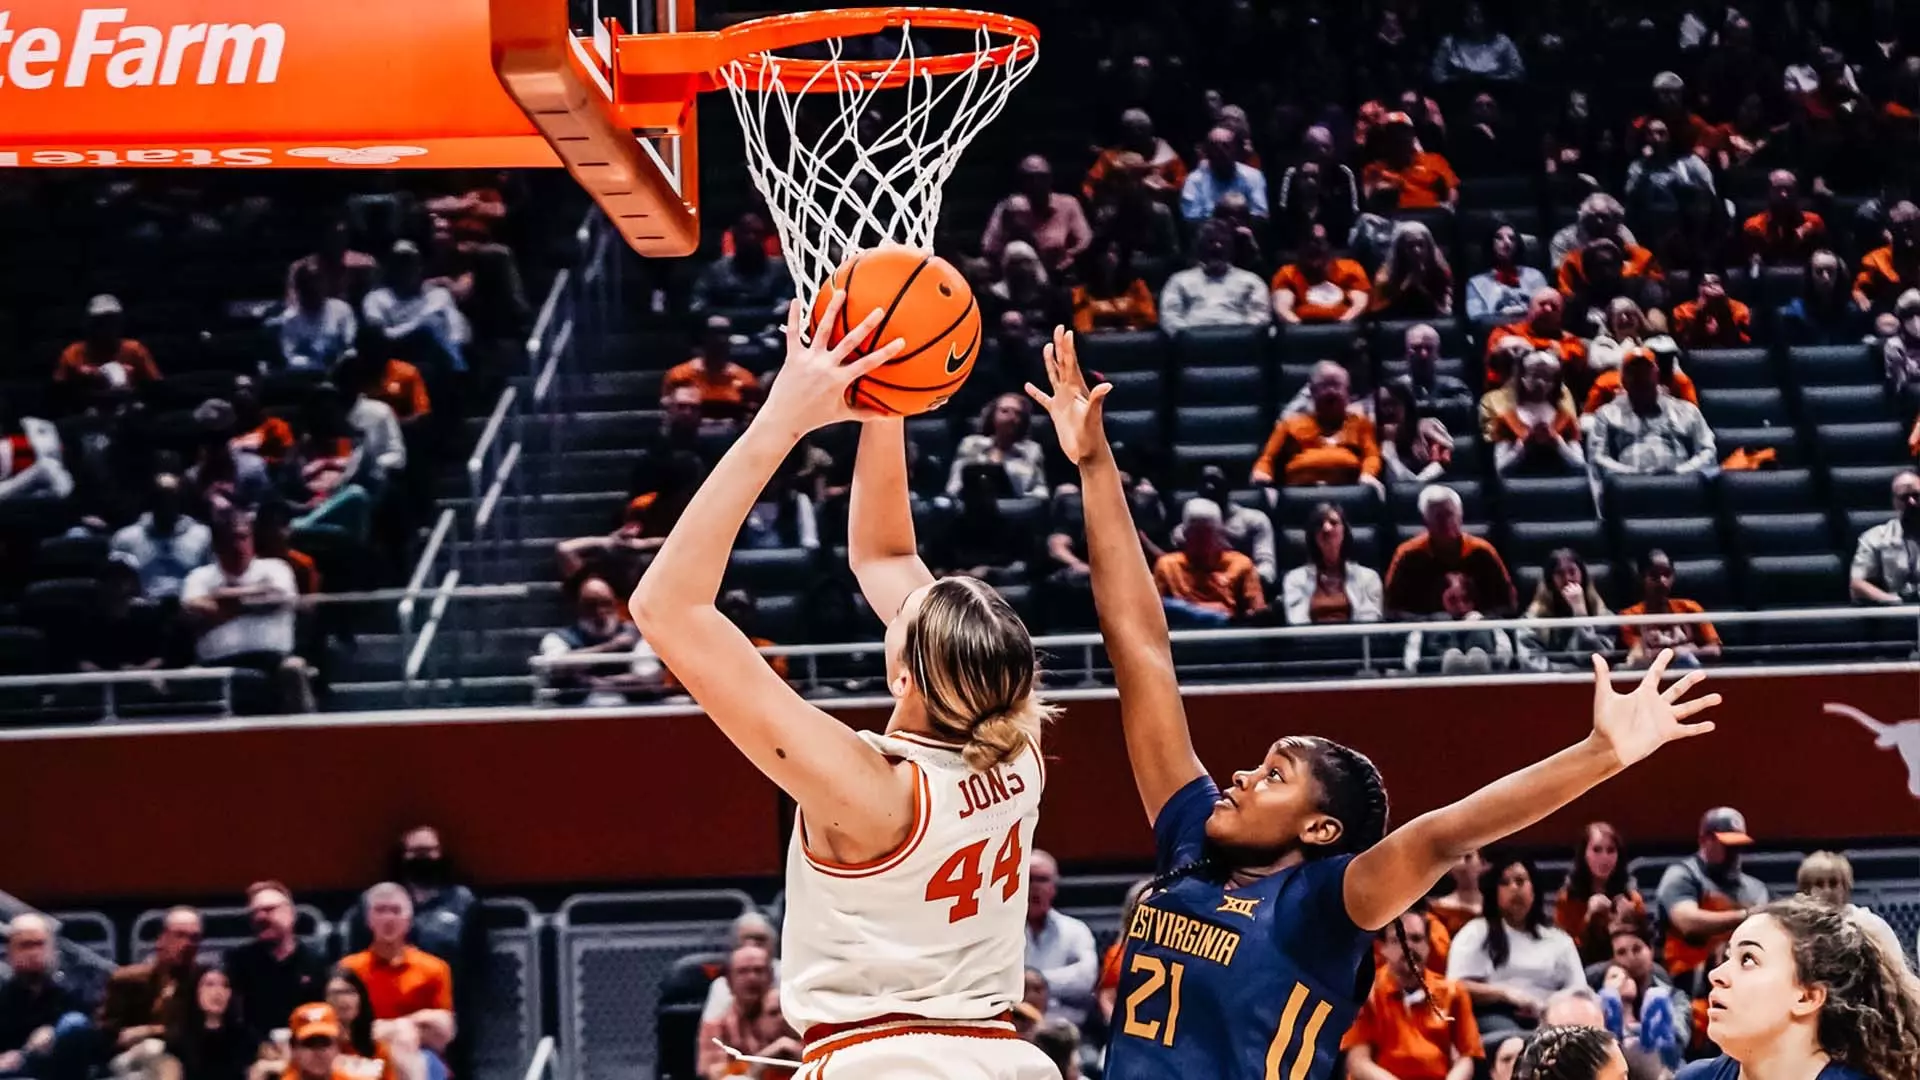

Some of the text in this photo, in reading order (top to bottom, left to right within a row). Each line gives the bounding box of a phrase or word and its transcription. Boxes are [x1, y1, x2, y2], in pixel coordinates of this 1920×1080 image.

[31, 147, 273, 167] State
[924, 817, 1023, 924] 44
[1128, 903, 1241, 967] EST VIRGINIA
[1123, 952, 1185, 1048] 21
